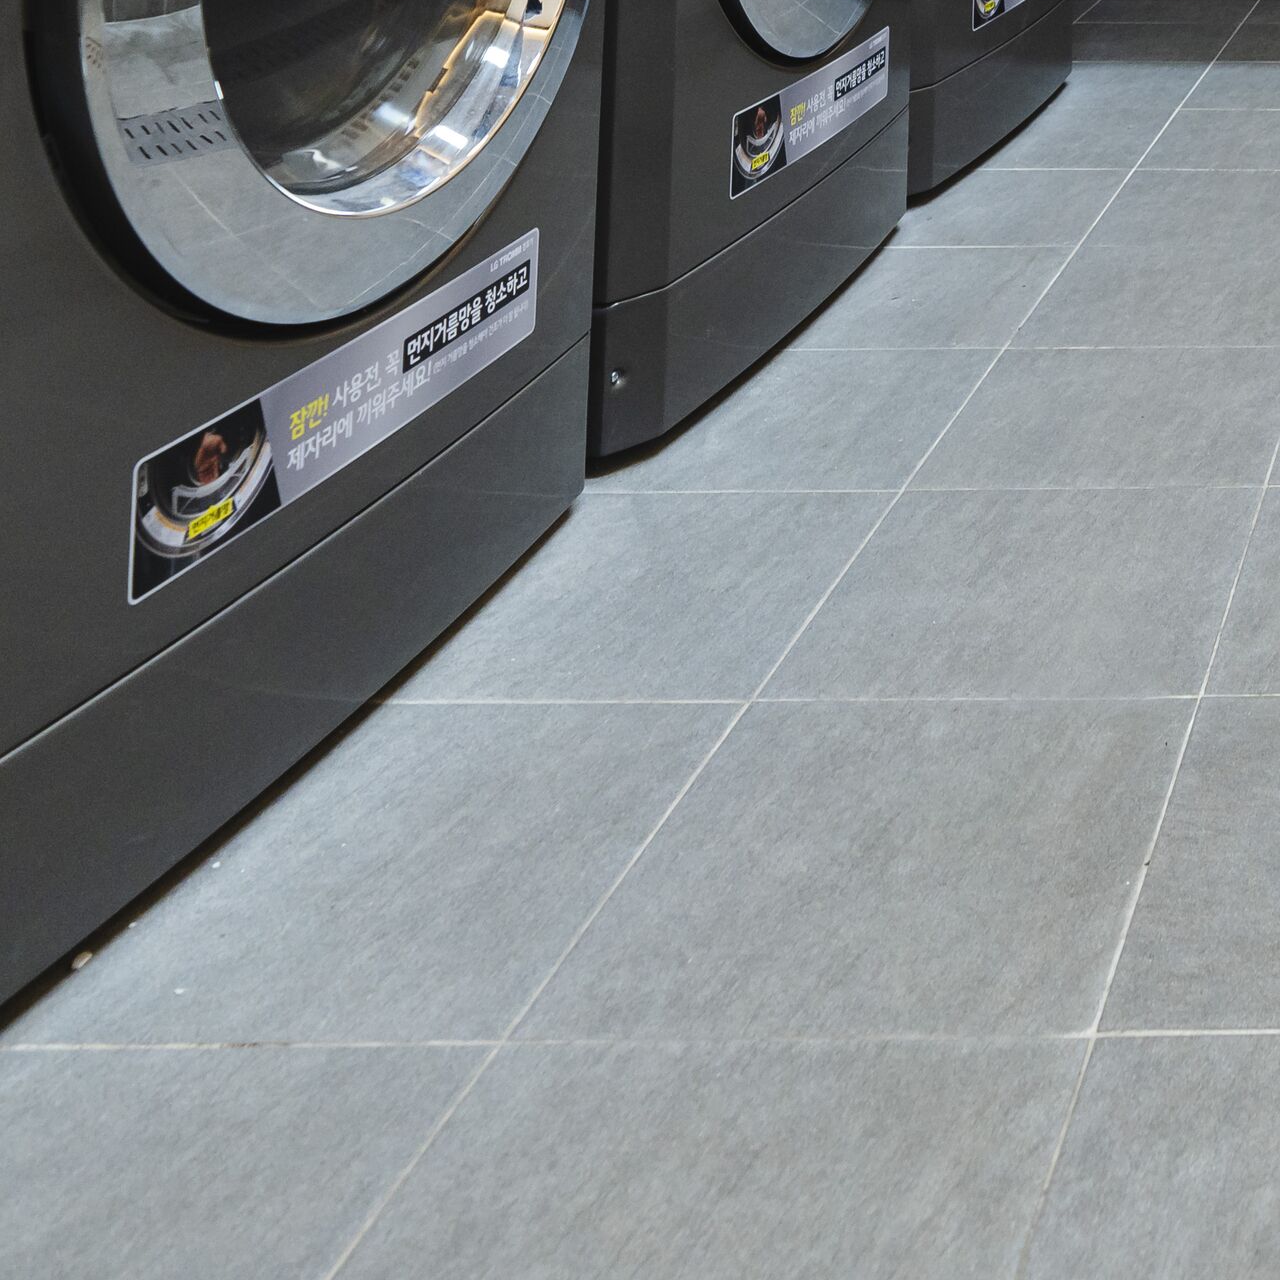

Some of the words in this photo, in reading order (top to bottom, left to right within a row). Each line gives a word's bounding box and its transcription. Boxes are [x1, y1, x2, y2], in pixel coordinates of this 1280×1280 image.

[490, 259, 499, 272] LG
[289, 393, 330, 440] 잠깐!
[332, 361, 382, 408] 사용전
[385, 349, 401, 376] 꼭
[407, 296, 483, 365] 먼지거름망을
[485, 266, 528, 314] 청소하고
[286, 410, 354, 470] 제자리에
[357, 360, 432, 425] 끼워주세요!
